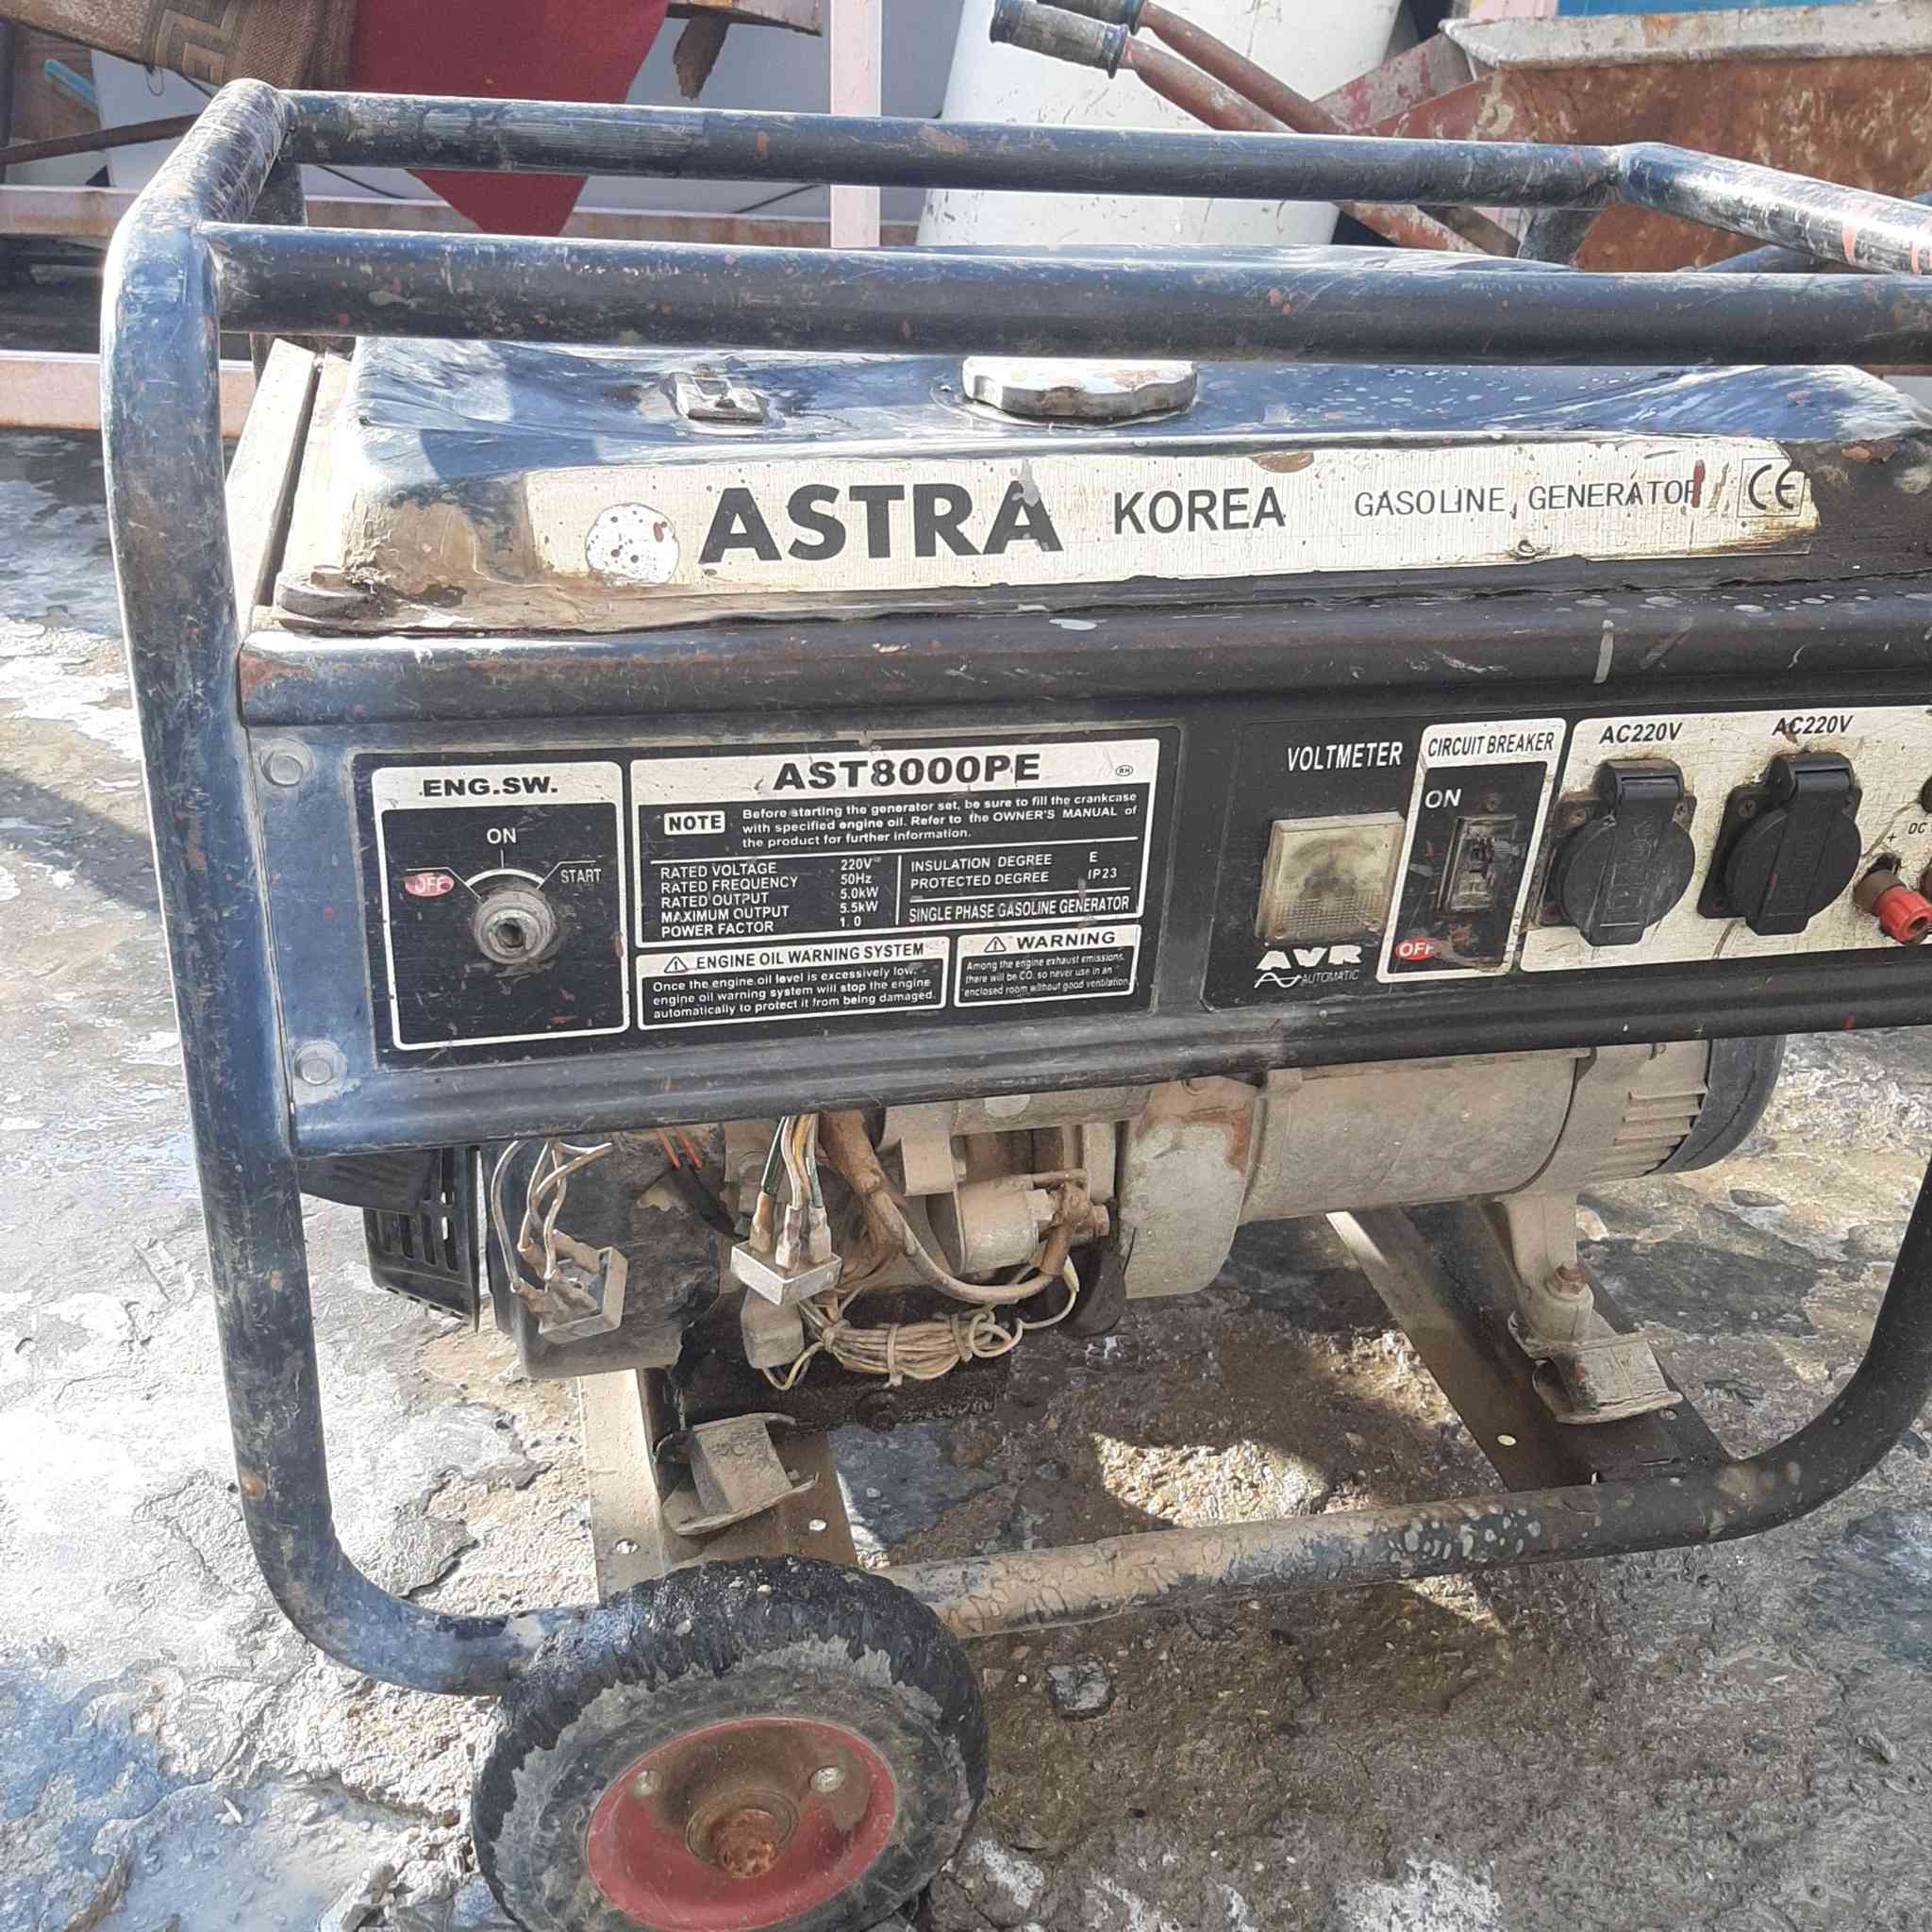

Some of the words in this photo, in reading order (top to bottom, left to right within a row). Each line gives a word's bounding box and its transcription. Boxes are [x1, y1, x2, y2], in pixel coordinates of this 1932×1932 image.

[1748, 464, 1795, 509] CE
[1355, 487, 1506, 517] GASOLINE
[698, 481, 1063, 563] ASTRA
[1114, 487, 1286, 534] KOREA
[1599, 722, 1683, 744] AC220V
[1773, 714, 1854, 737] AC220V
[1427, 735, 1484, 757] CIRCUIT
[1487, 731, 1556, 754] BREAKER
[1287, 741, 1404, 772] VOLTMETER
[773, 753, 1041, 791] AST8000PE
[423, 775, 558, 797] ENG.SW.
[742, 808, 787, 820] Before
[791, 806, 843, 818] starting
[846, 805, 867, 815] the
[871, 802, 934, 816] generator
[964, 800, 980, 809] be
[984, 800, 1012, 808] sure
[1015, 797, 1028, 807] to
[1031, 795, 1048, 807] fill
[1051, 795, 1071, 805] the
[1074, 793, 1138, 805] crankcase
[1424, 788, 1462, 808] ON
[668, 814, 723, 831] NOTE
[741, 823, 771, 834] with
[774, 820, 836, 834] specified
[839, 819, 883, 831] engine
[887, 817, 907, 827] oil.
[910, 815, 945, 826] Refer
[949, 815, 962, 824] to
[969, 812, 989, 824] the
[992, 808, 1056, 823] OWNER'S
[1062, 807, 1118, 819] MANUAL
[1124, 806, 1138, 816] of
[1907, 822, 1927, 835] DC
[486, 828, 517, 845] ON
[742, 838, 764, 848] the
[768, 836, 820, 849] product
[824, 834, 843, 844] for
[845, 832, 891, 844] further
[893, 828, 972, 841] information.
[841, 858, 873, 872] 220V
[910, 858, 991, 873] INSULATION
[997, 854, 1053, 868] DEGREE
[1089, 851, 1099, 862] E
[559, 868, 602, 885] START
[660, 866, 708, 879] RATED
[711, 861, 778, 877] VOLTAGE
[840, 873, 873, 886] 50Hz
[1088, 868, 1118, 880] IP23
[660, 881, 708, 894] RATED
[712, 875, 799, 891] FREQUENCY
[910, 874, 991, 890] PROTECTED
[994, 871, 1050, 885] DEGREE
[660, 895, 708, 909] RATED
[712, 891, 769, 907] OUTPUT
[840, 886, 879, 900] 5.0kW
[660, 909, 729, 924] MAXIMUM
[733, 905, 791, 920] OUTPUT
[840, 900, 879, 914] 5.5kW
[908, 906, 952, 923] SINGLE
[955, 903, 995, 920] PHASE
[997, 900, 1057, 918] GASOLINE
[1058, 895, 1130, 913] GENERATOR
[661, 924, 714, 939] POWER
[718, 921, 774, 936] FACTOR
[1017, 930, 1116, 950] WARNING
[1398, 941, 1435, 958] OFF
[696, 954, 755, 970] ENGINE
[758, 952, 784, 965] OIL
[788, 947, 859, 963] WARNING
[864, 942, 924, 959] SYSTEM
[966, 961, 998, 972] Among
[999, 959, 1014, 969] the
[1015, 958, 1044, 970] engine
[1045, 955, 1079, 966] exhaust
[1256, 944, 1363, 970] AVR
[653, 981, 685, 992] Once
[689, 978, 708, 990] the
[711, 977, 754, 991] engine
[757, 974, 772, 986] oil
[775, 973, 803, 984] level
[808, 972, 817, 981] is
[821, 967, 890, 980] excessively
[965, 974, 988, 984] there
[990, 973, 1005, 982] will
[1006, 973, 1018, 981] be
[1049, 969, 1074, 978] never
[1074, 968, 1091, 976] use
[1092, 967, 1100, 975] in
[1101, 966, 1113, 974] an
[1301, 969, 1359, 984] AUTOMATIC
[653, 994, 694, 1007] engine
[698, 991, 713, 1002] oil
[717, 989, 766, 1001] warning
[770, 986, 813, 998] system
[817, 983, 837, 993] will
[841, 981, 866, 992] stop
[869, 979, 888, 990] the
[891, 977, 931, 990] engine
[964, 984, 1004, 997] enclosed
[1005, 985, 1028, 995] room
[1029, 980, 1061, 992] without
[1062, 979, 1085, 992] good
[653, 1004, 736, 1019] automatically
[740, 1003, 751, 1012] to
[755, 999, 798, 1013] protect
[801, 998, 808, 1008] it
[812, 996, 840, 1007] from
[842, 993, 875, 1006] being
[879, 990, 936, 1003] damaged.
